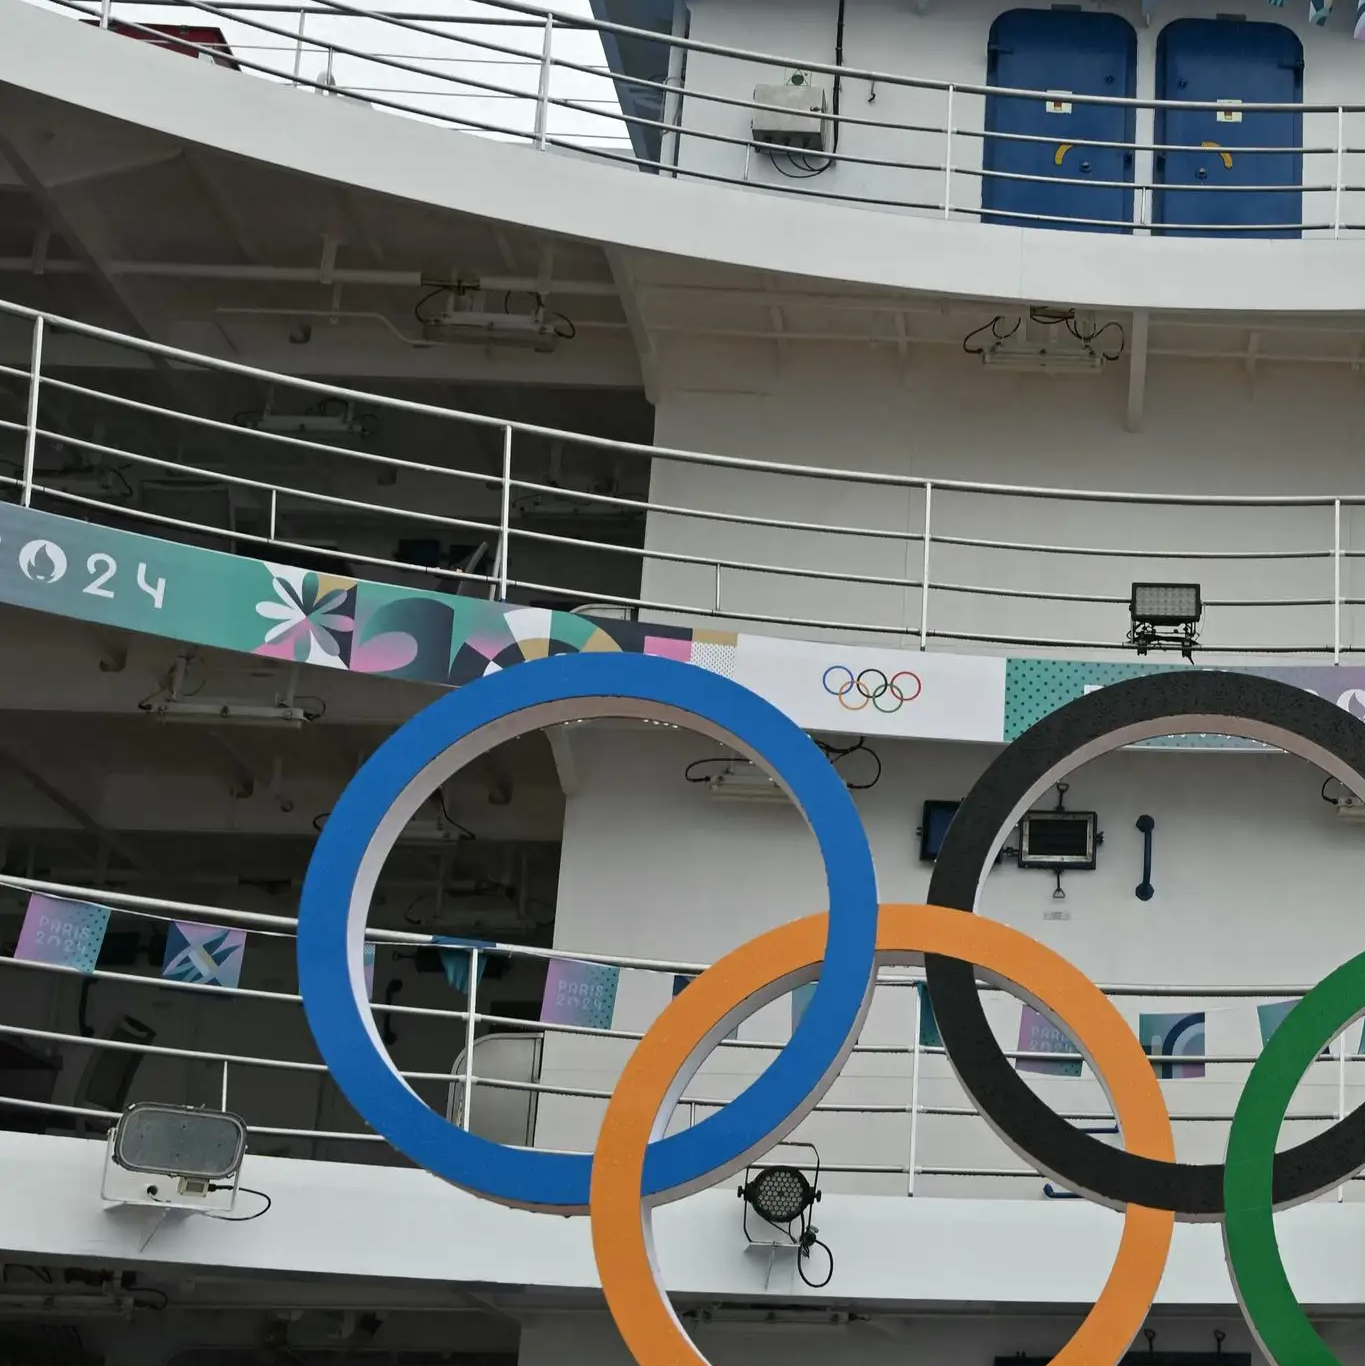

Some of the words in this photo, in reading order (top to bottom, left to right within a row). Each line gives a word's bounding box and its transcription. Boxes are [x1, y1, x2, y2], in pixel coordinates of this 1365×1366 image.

[39, 916, 90, 939] PARIS
[35, 931, 86, 955] 2024
[558, 980, 603, 996] PARIS
[556, 994, 602, 1011] 2024
